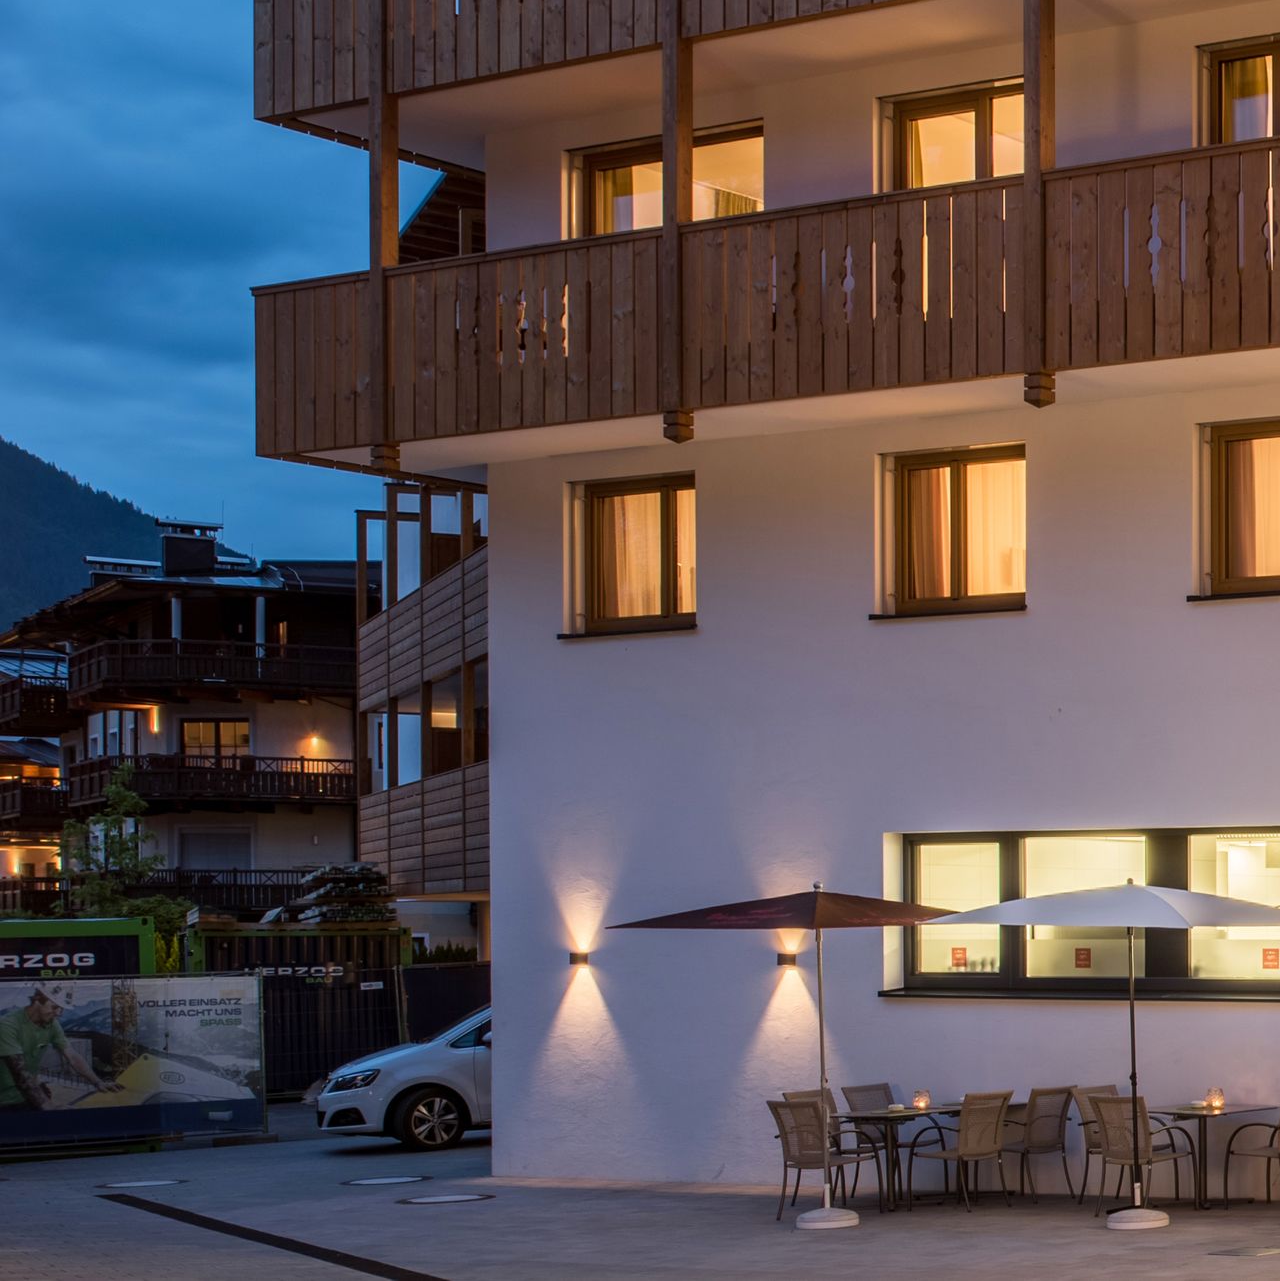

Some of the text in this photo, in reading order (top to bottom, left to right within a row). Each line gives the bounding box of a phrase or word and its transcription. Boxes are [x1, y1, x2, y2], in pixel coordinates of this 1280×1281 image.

[41, 969, 80, 977] BAU
[138, 997, 242, 1008] VOLLER EINSATZ
[165, 1008, 242, 1018] MACHT UNS
[200, 1018, 242, 1027] SPASS
